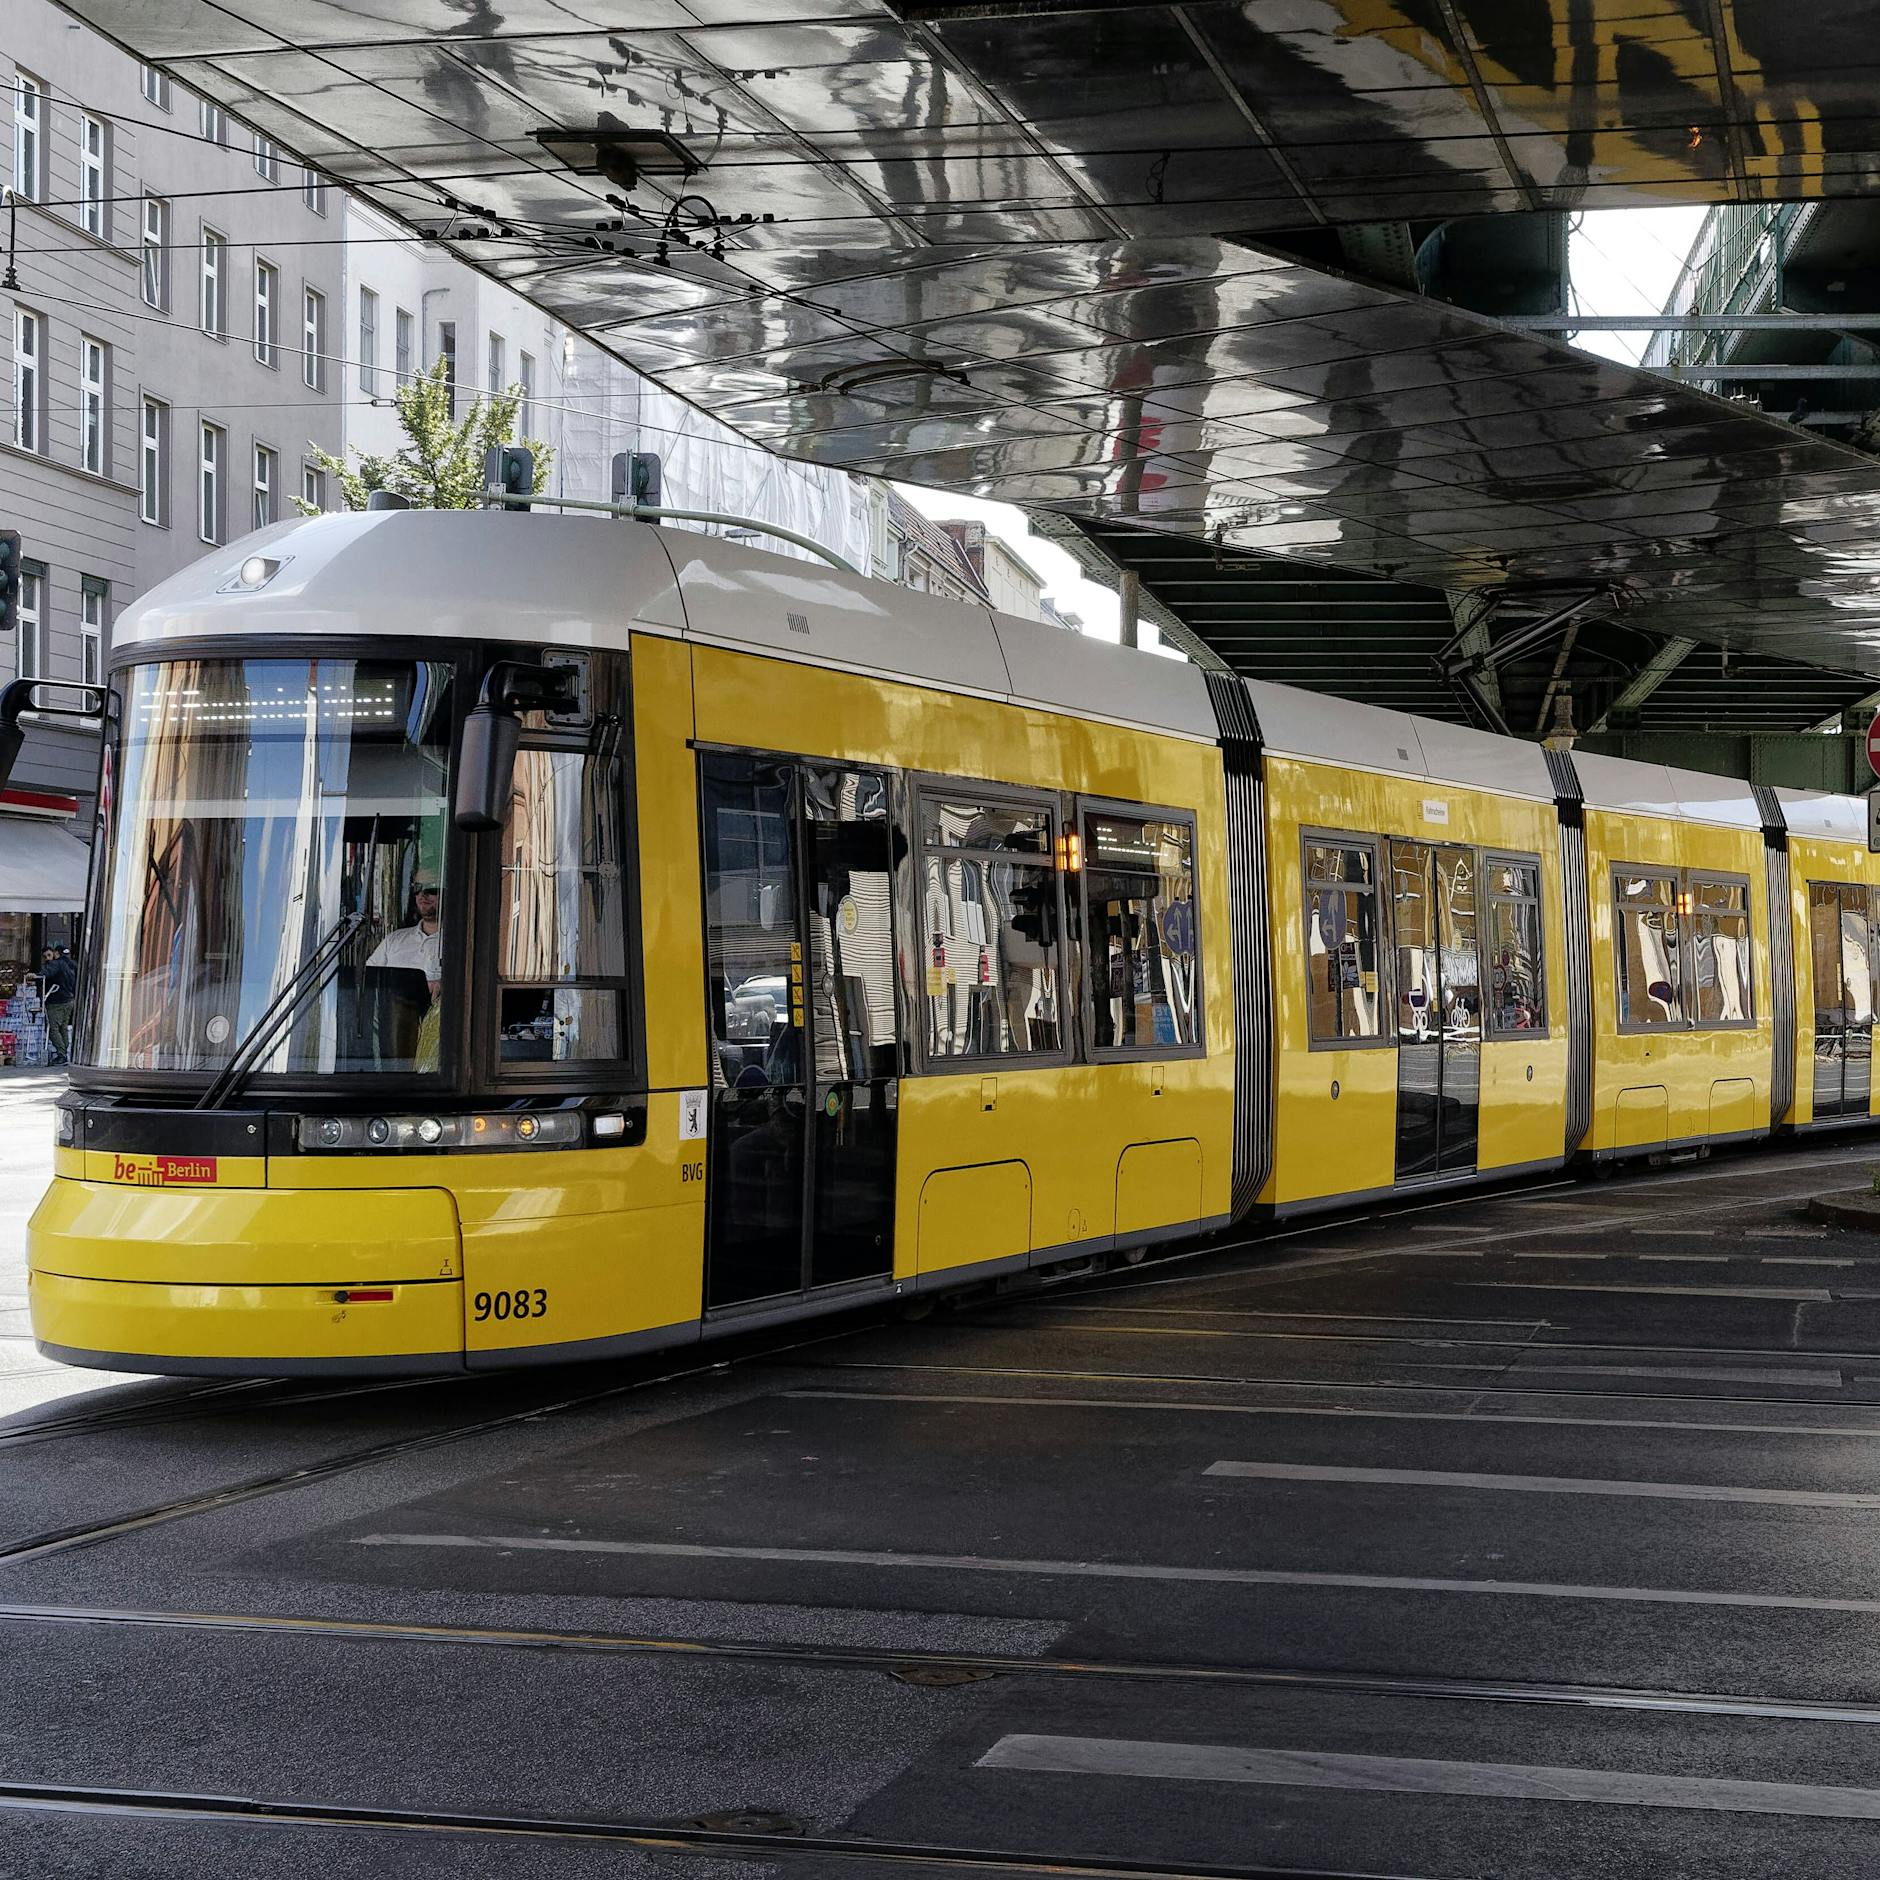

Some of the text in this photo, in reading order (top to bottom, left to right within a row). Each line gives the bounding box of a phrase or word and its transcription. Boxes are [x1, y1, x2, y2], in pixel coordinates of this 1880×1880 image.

[114, 1155, 211, 1180] be Berlin
[682, 1162, 703, 1183] BVG
[474, 1288, 547, 1322] 9083
